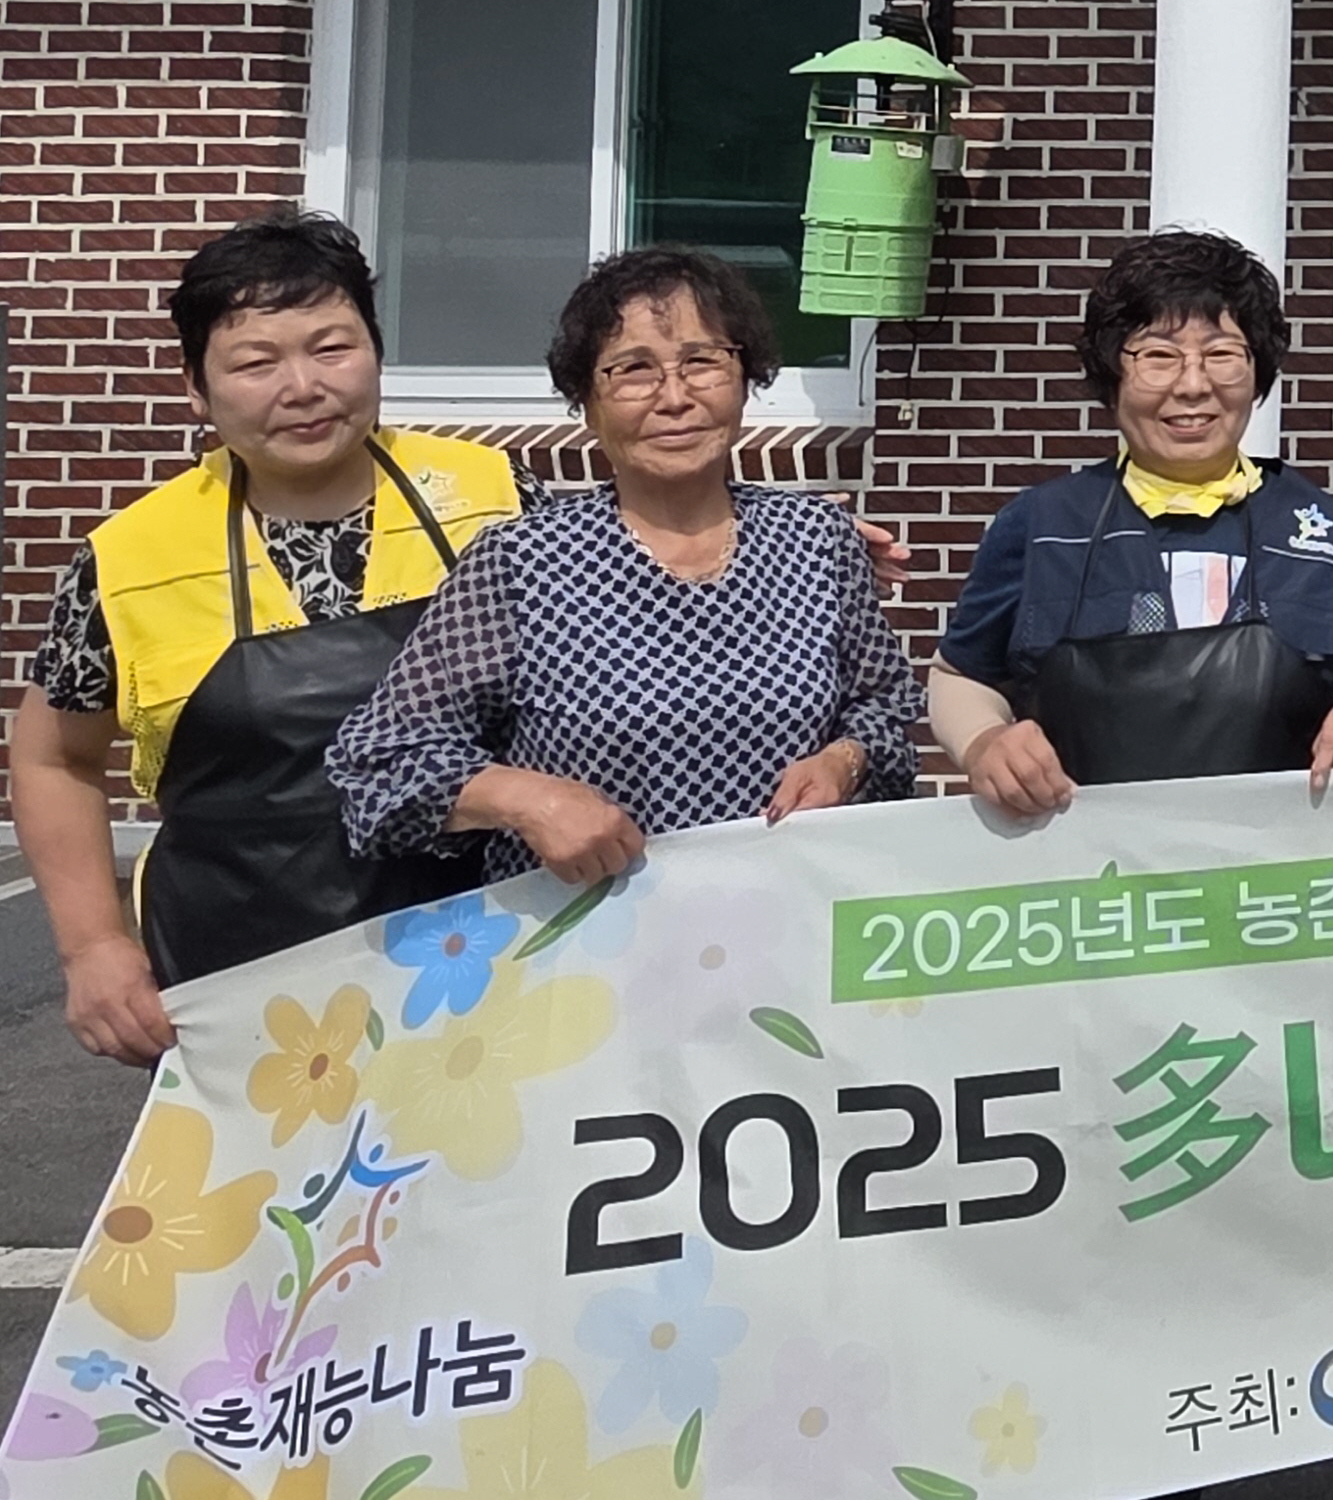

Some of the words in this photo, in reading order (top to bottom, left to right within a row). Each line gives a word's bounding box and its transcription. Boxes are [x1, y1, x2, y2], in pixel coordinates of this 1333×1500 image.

[862, 888, 1210, 982] 2025년도
[566, 1066, 1067, 1275] 2025
[121, 1320, 526, 1471] 농촌재능나눔
[1165, 1368, 1298, 1452] 주최:
